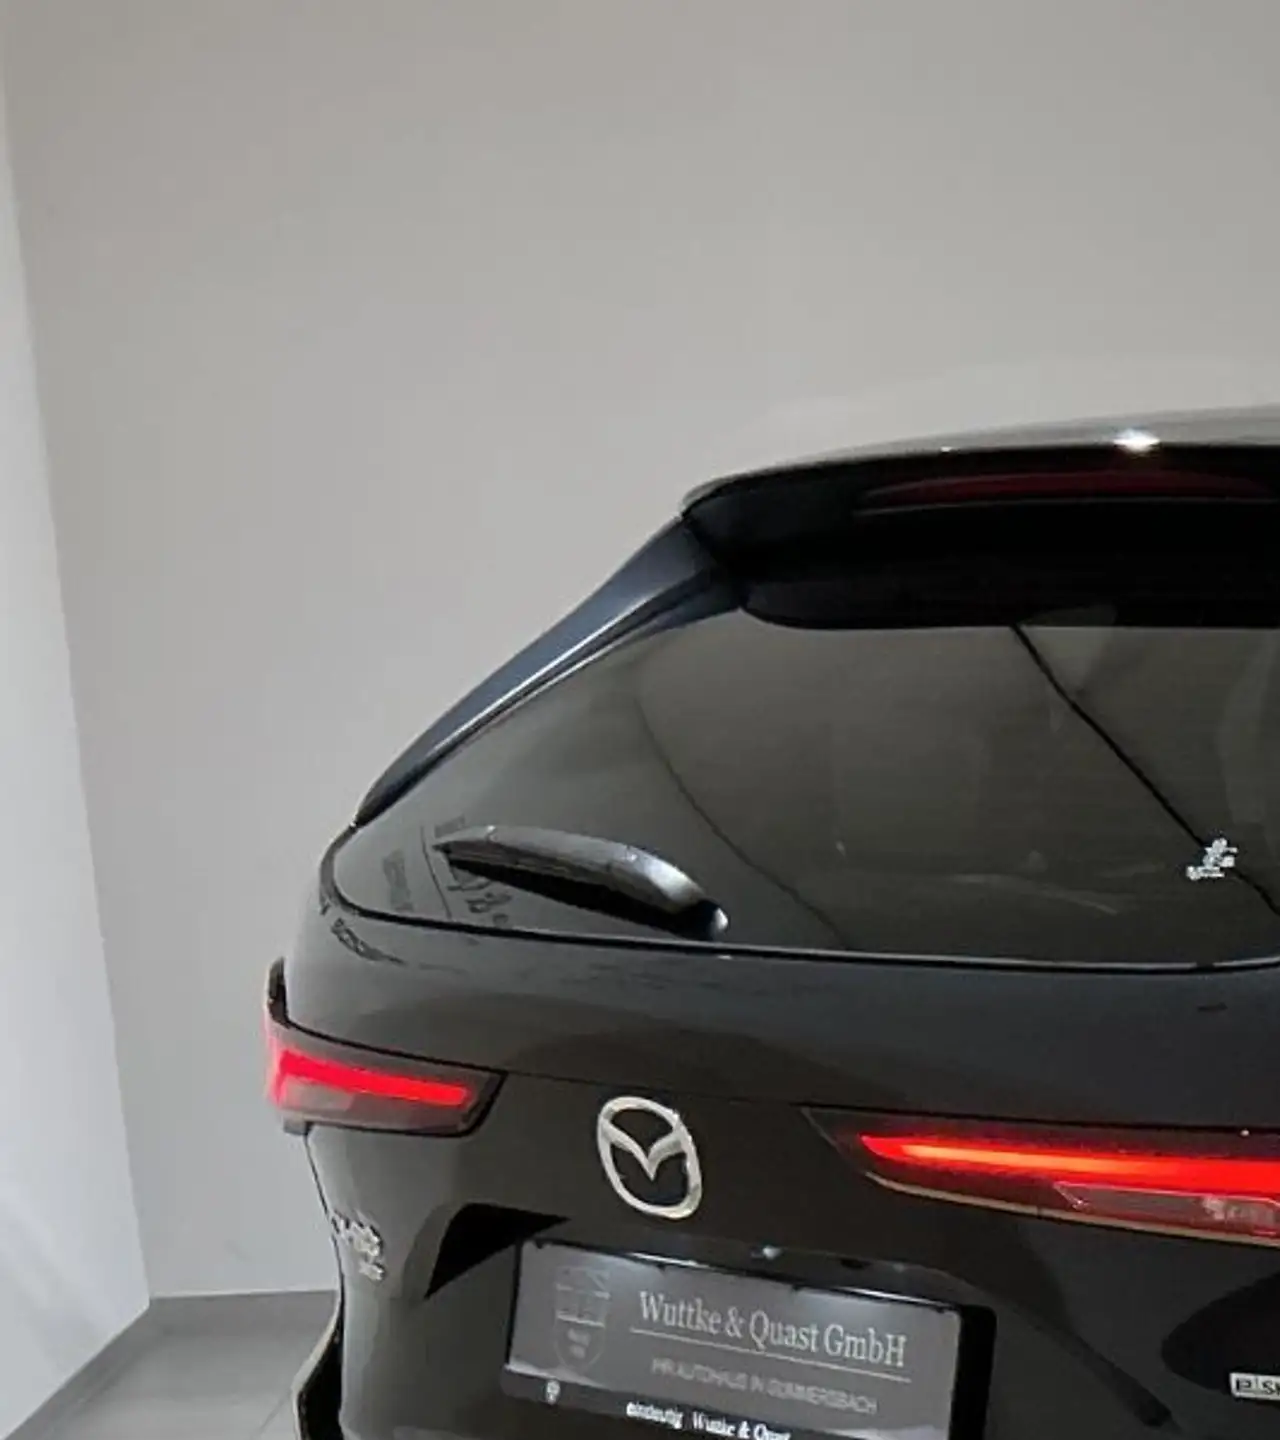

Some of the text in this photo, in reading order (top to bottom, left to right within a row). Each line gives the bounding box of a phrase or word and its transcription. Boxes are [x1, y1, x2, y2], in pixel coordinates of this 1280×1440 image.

[639, 1290, 907, 1368] Wuttke & Quast GmbH
[737, 1420, 751, 1440] &
